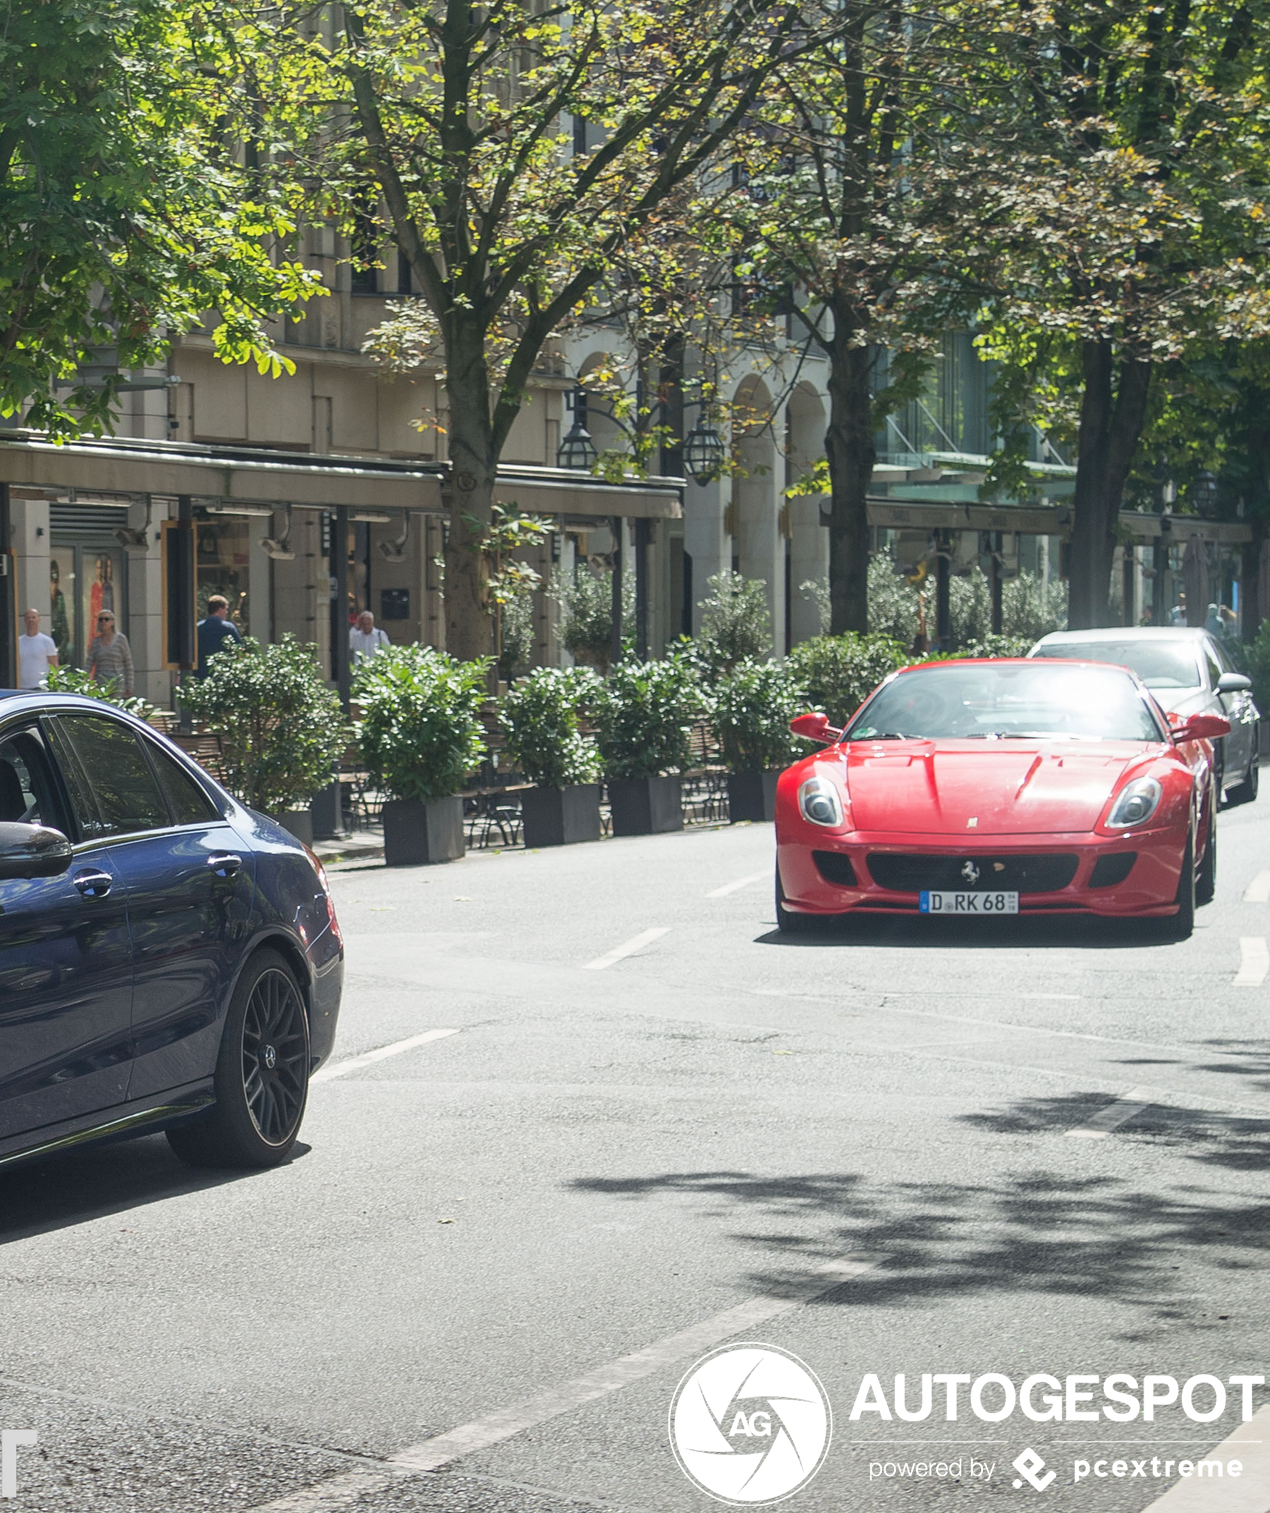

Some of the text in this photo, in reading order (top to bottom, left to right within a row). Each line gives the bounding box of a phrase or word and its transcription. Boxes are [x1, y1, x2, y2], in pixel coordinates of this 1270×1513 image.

[932, 894, 1005, 911] D RK 68
